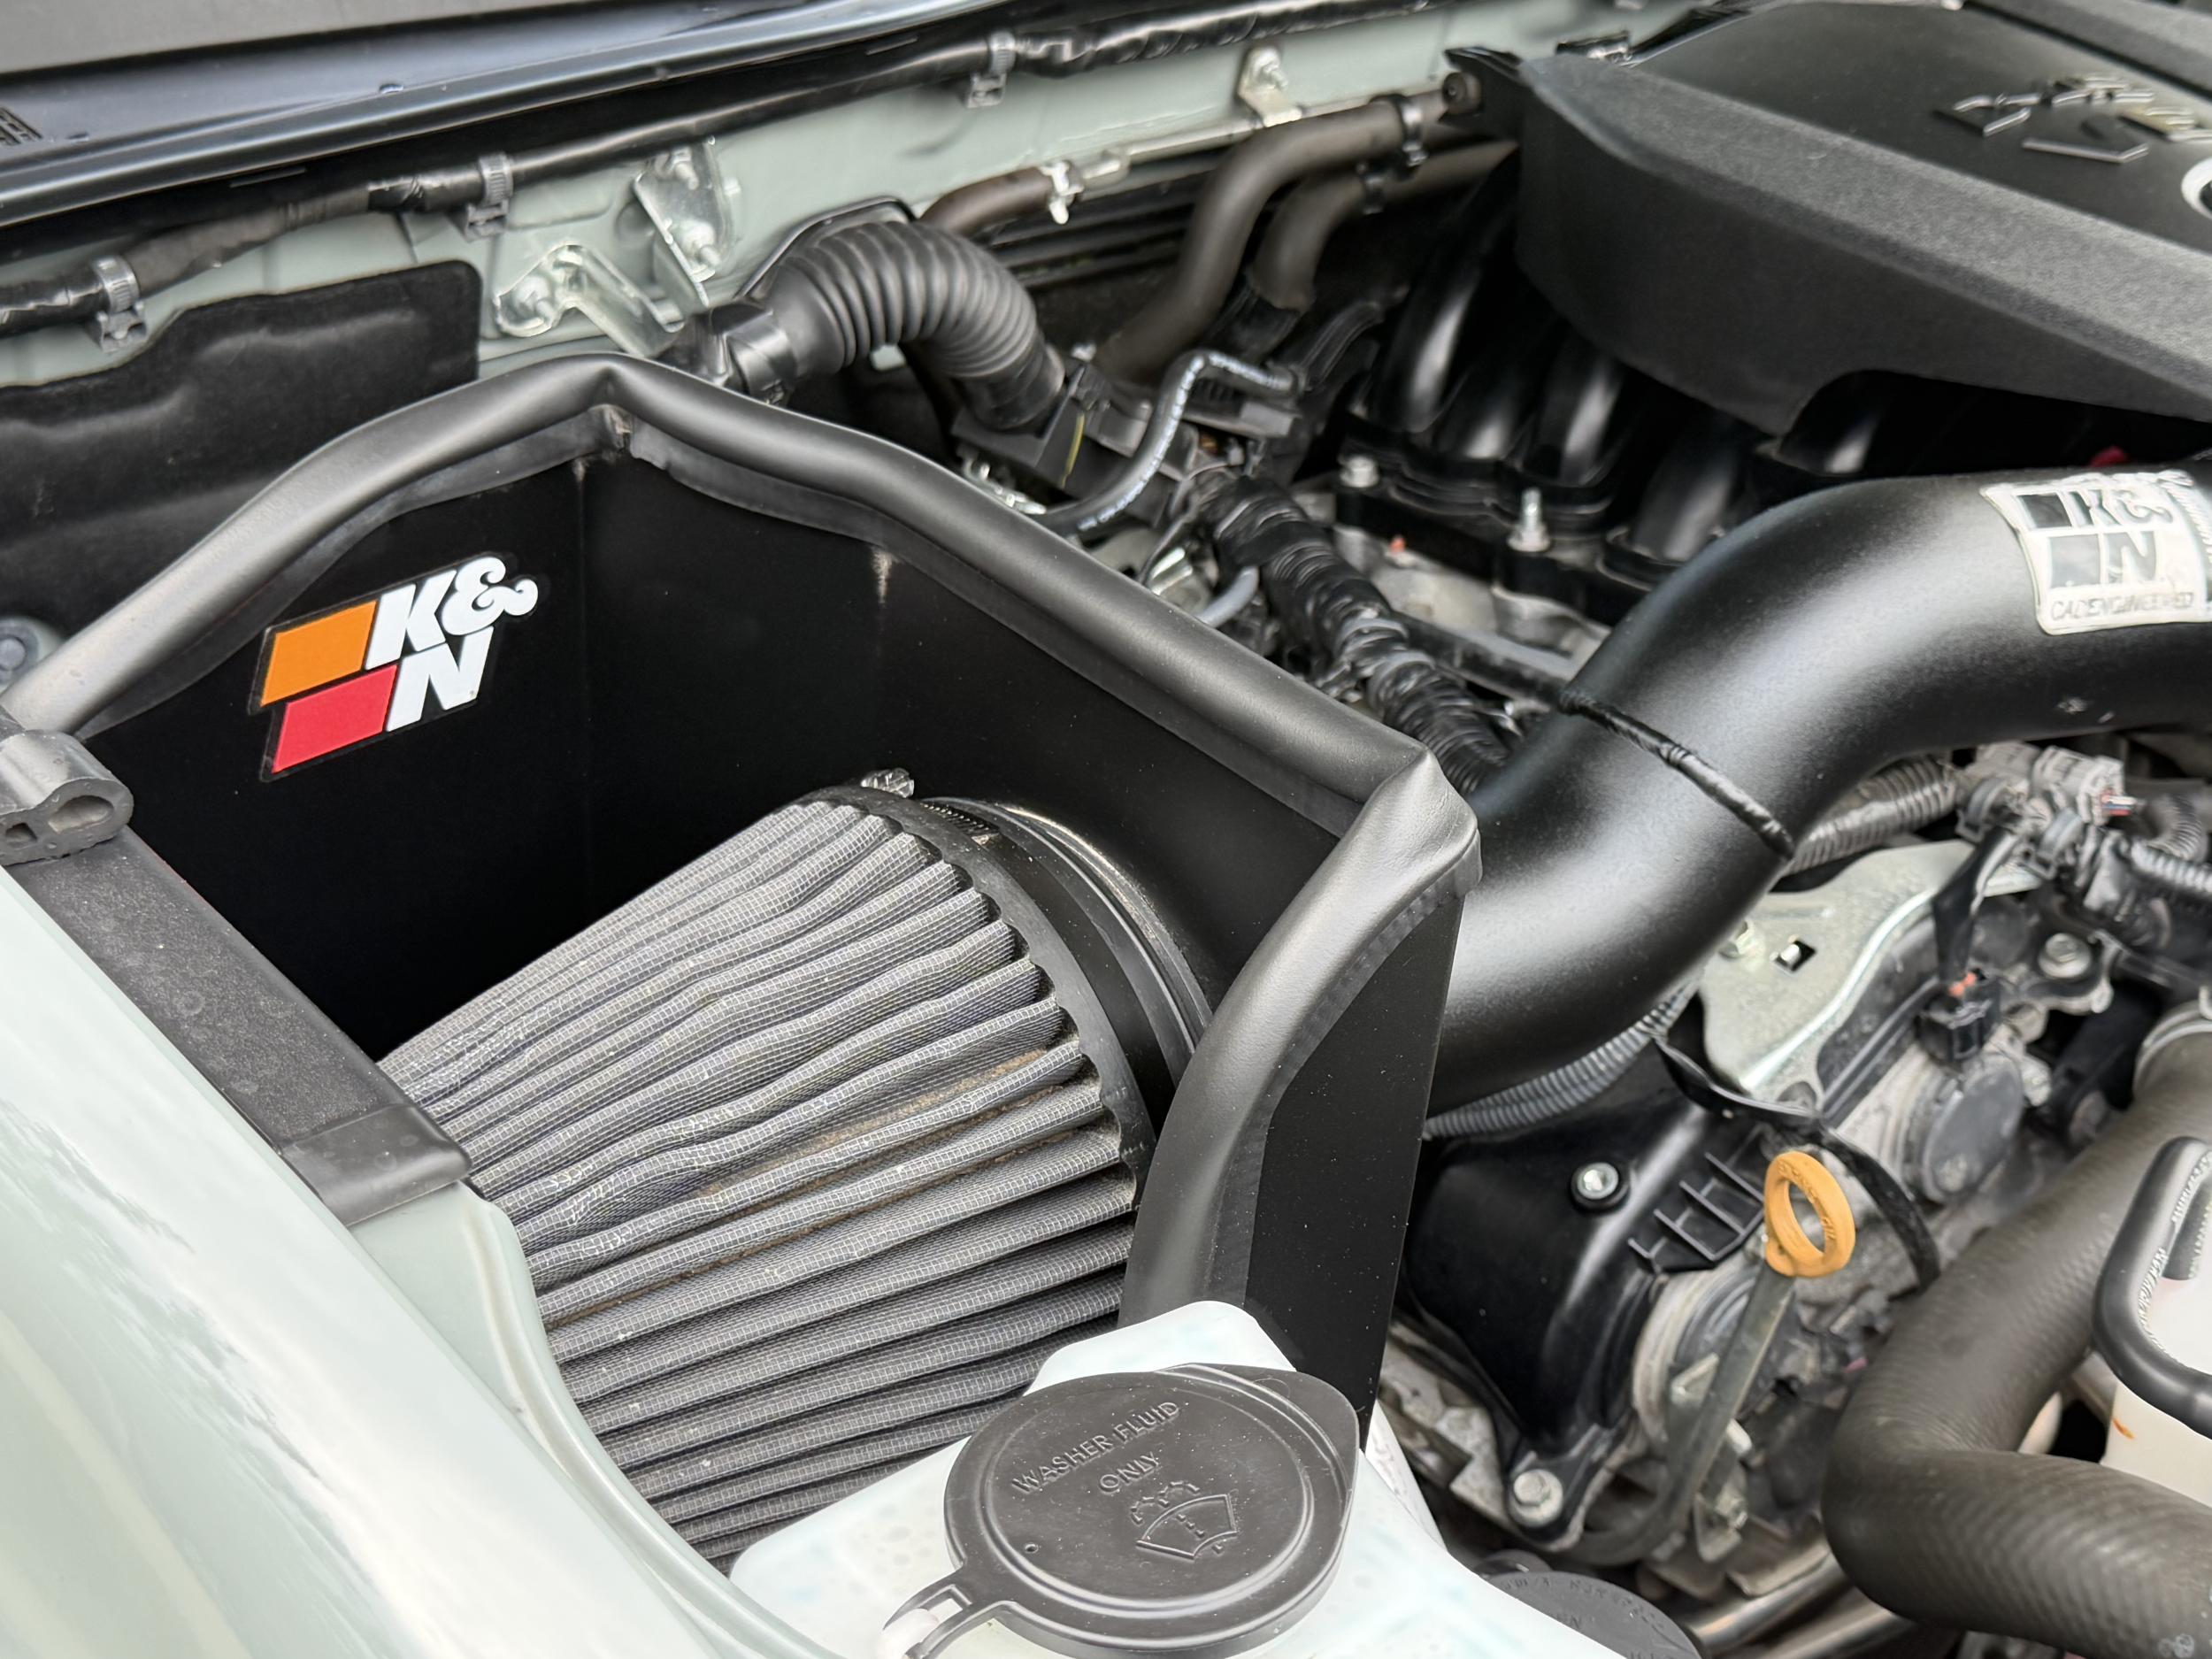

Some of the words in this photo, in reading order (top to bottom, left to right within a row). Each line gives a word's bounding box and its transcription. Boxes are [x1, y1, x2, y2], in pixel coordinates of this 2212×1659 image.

[365, 556, 539, 671] K&
[386, 626, 495, 733] N
[1011, 1434, 1114, 1494] WASHER
[1113, 1401, 1180, 1443] FLUID
[1098, 1451, 1162, 1494] ONLY
